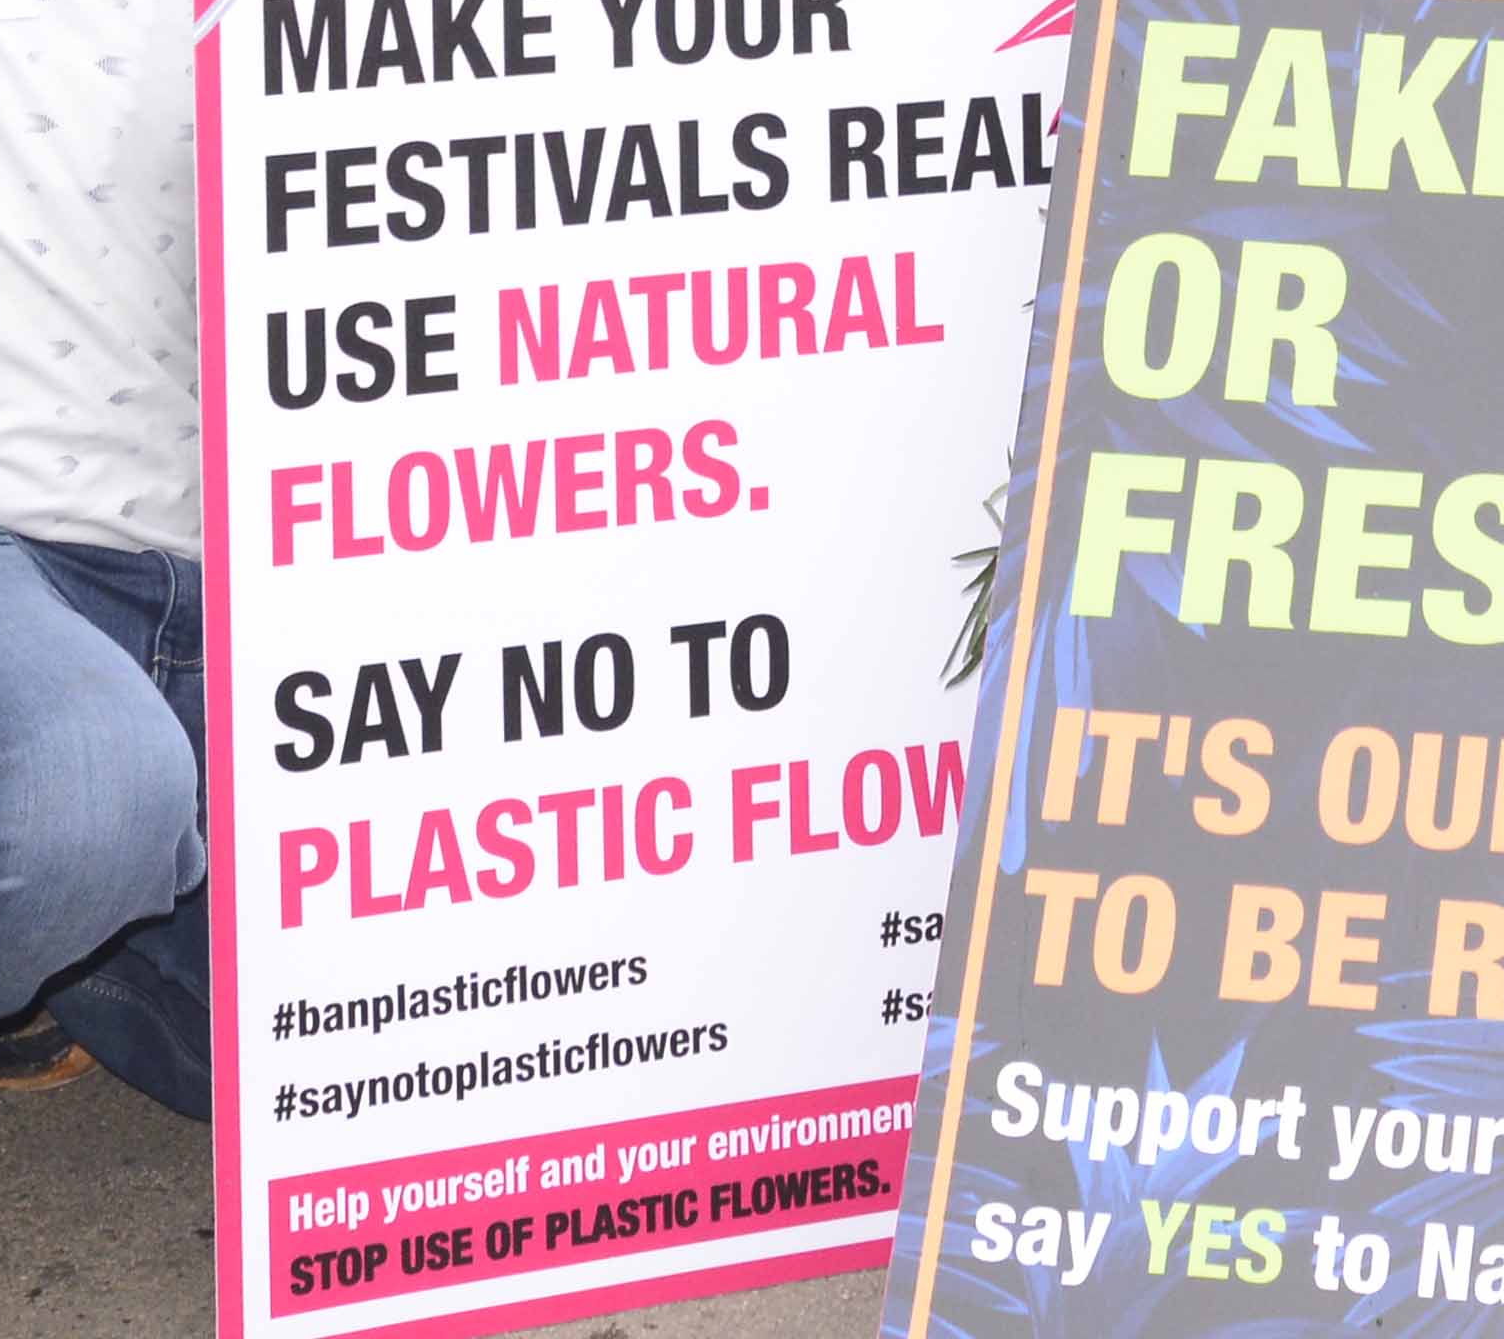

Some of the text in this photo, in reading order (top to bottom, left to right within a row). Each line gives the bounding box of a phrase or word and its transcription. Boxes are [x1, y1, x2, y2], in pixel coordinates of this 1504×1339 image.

[264, 92, 1056, 255] FESTIVALS REAL
[266, 251, 946, 412] USE NATURAL
[1101, 233, 1349, 408] OR
[270, 418, 771, 568] FLOWERS.
[272, 613, 791, 774] SAY NO TO
[278, 738, 967, 931] PLASTIC FLOW
[1039, 707, 1273, 837] IT'S
[272, 952, 648, 1042] #banplasticflowers
[1022, 869, 1174, 996] TO
[1215, 883, 1385, 1012] BE
[273, 1017, 729, 1123] #saynotoplasticflowers
[991, 1061, 1305, 1166] Support
[289, 1100, 917, 1234] Help yourself and your environmen
[289, 1157, 891, 1297] STOP USE OF PLASTIC FLOWERS.
[969, 1199, 1112, 1289] say
[1136, 1202, 1287, 1285] YES
[1311, 1222, 1391, 1295] to
